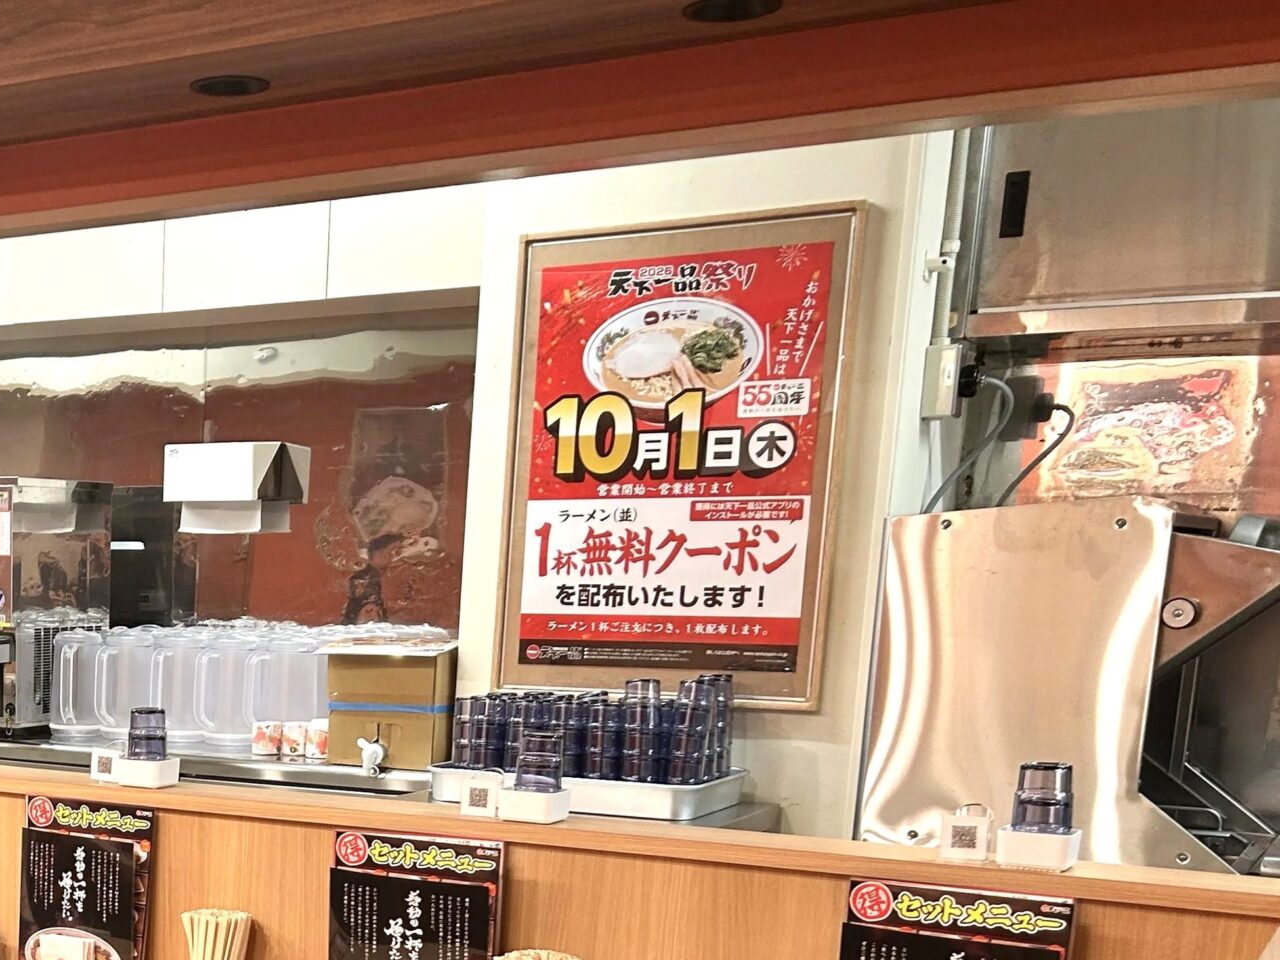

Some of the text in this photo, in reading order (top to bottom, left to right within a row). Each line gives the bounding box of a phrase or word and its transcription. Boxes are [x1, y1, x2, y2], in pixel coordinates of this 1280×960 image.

[607, 261, 756, 297] 天下一品祭り
[640, 267, 671, 277] 2026
[792, 281, 818, 363] おかげさまで
[774, 308, 798, 375] 天下一品は
[546, 389, 743, 478] 10月1日
[535, 521, 798, 578] 1杯無料クーポン
[555, 584, 765, 608] を配布いたします!
[55, 804, 151, 831] セットメニュー
[371, 841, 495, 872] セットメニュー
[895, 893, 1065, 933] セットメニュー
